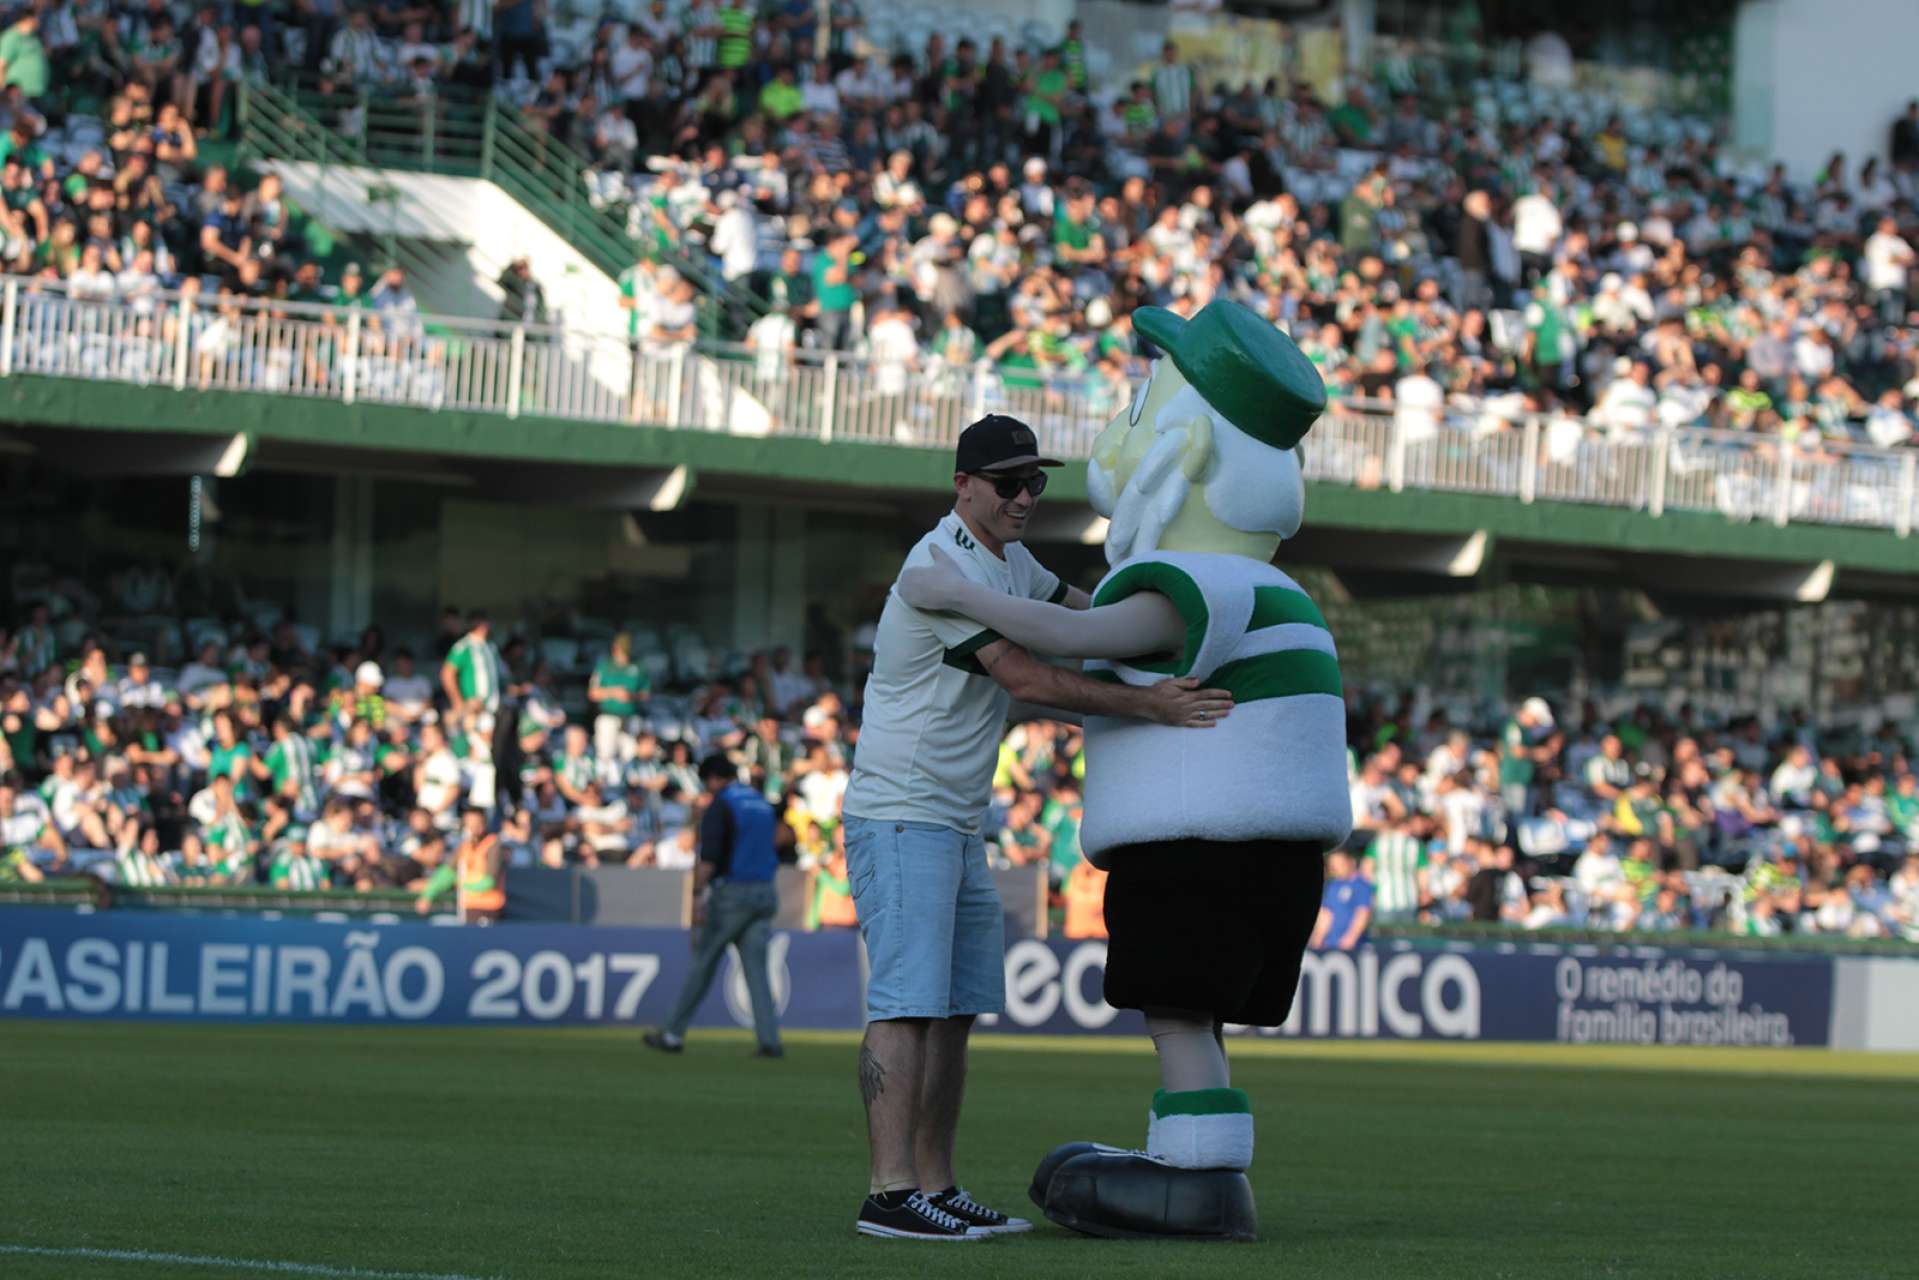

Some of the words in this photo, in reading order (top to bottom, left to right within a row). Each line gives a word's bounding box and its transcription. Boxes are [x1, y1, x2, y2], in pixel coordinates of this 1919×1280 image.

[0, 931, 446, 1019] ASILEIRÃO
[467, 949, 661, 1021] 2017
[977, 938, 1121, 1029] eo
[1222, 948, 1482, 1039] mica
[1555, 957, 1583, 1001] O
[1584, 959, 1703, 1004] remédio
